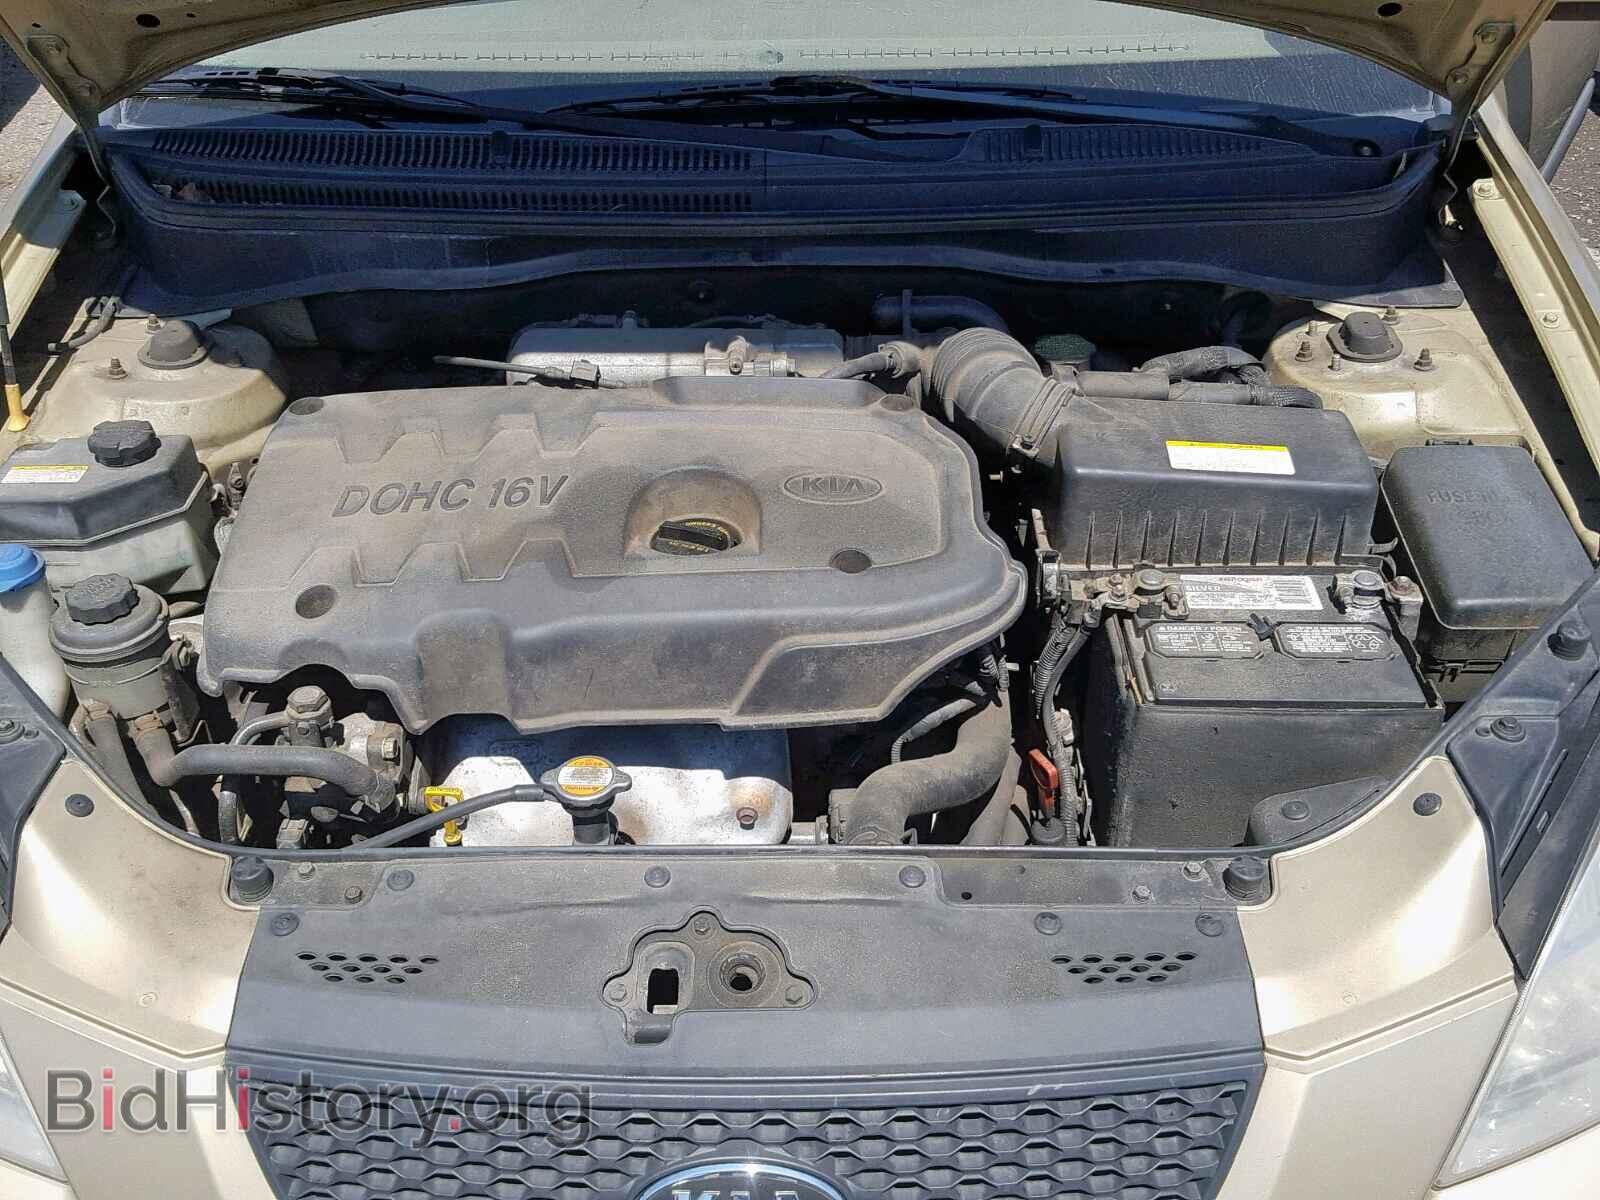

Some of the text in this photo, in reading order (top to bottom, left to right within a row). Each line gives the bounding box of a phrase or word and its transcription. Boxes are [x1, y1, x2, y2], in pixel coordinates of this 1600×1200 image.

[331, 474, 569, 517] DOHC 16V
[801, 476, 865, 497] KIA
